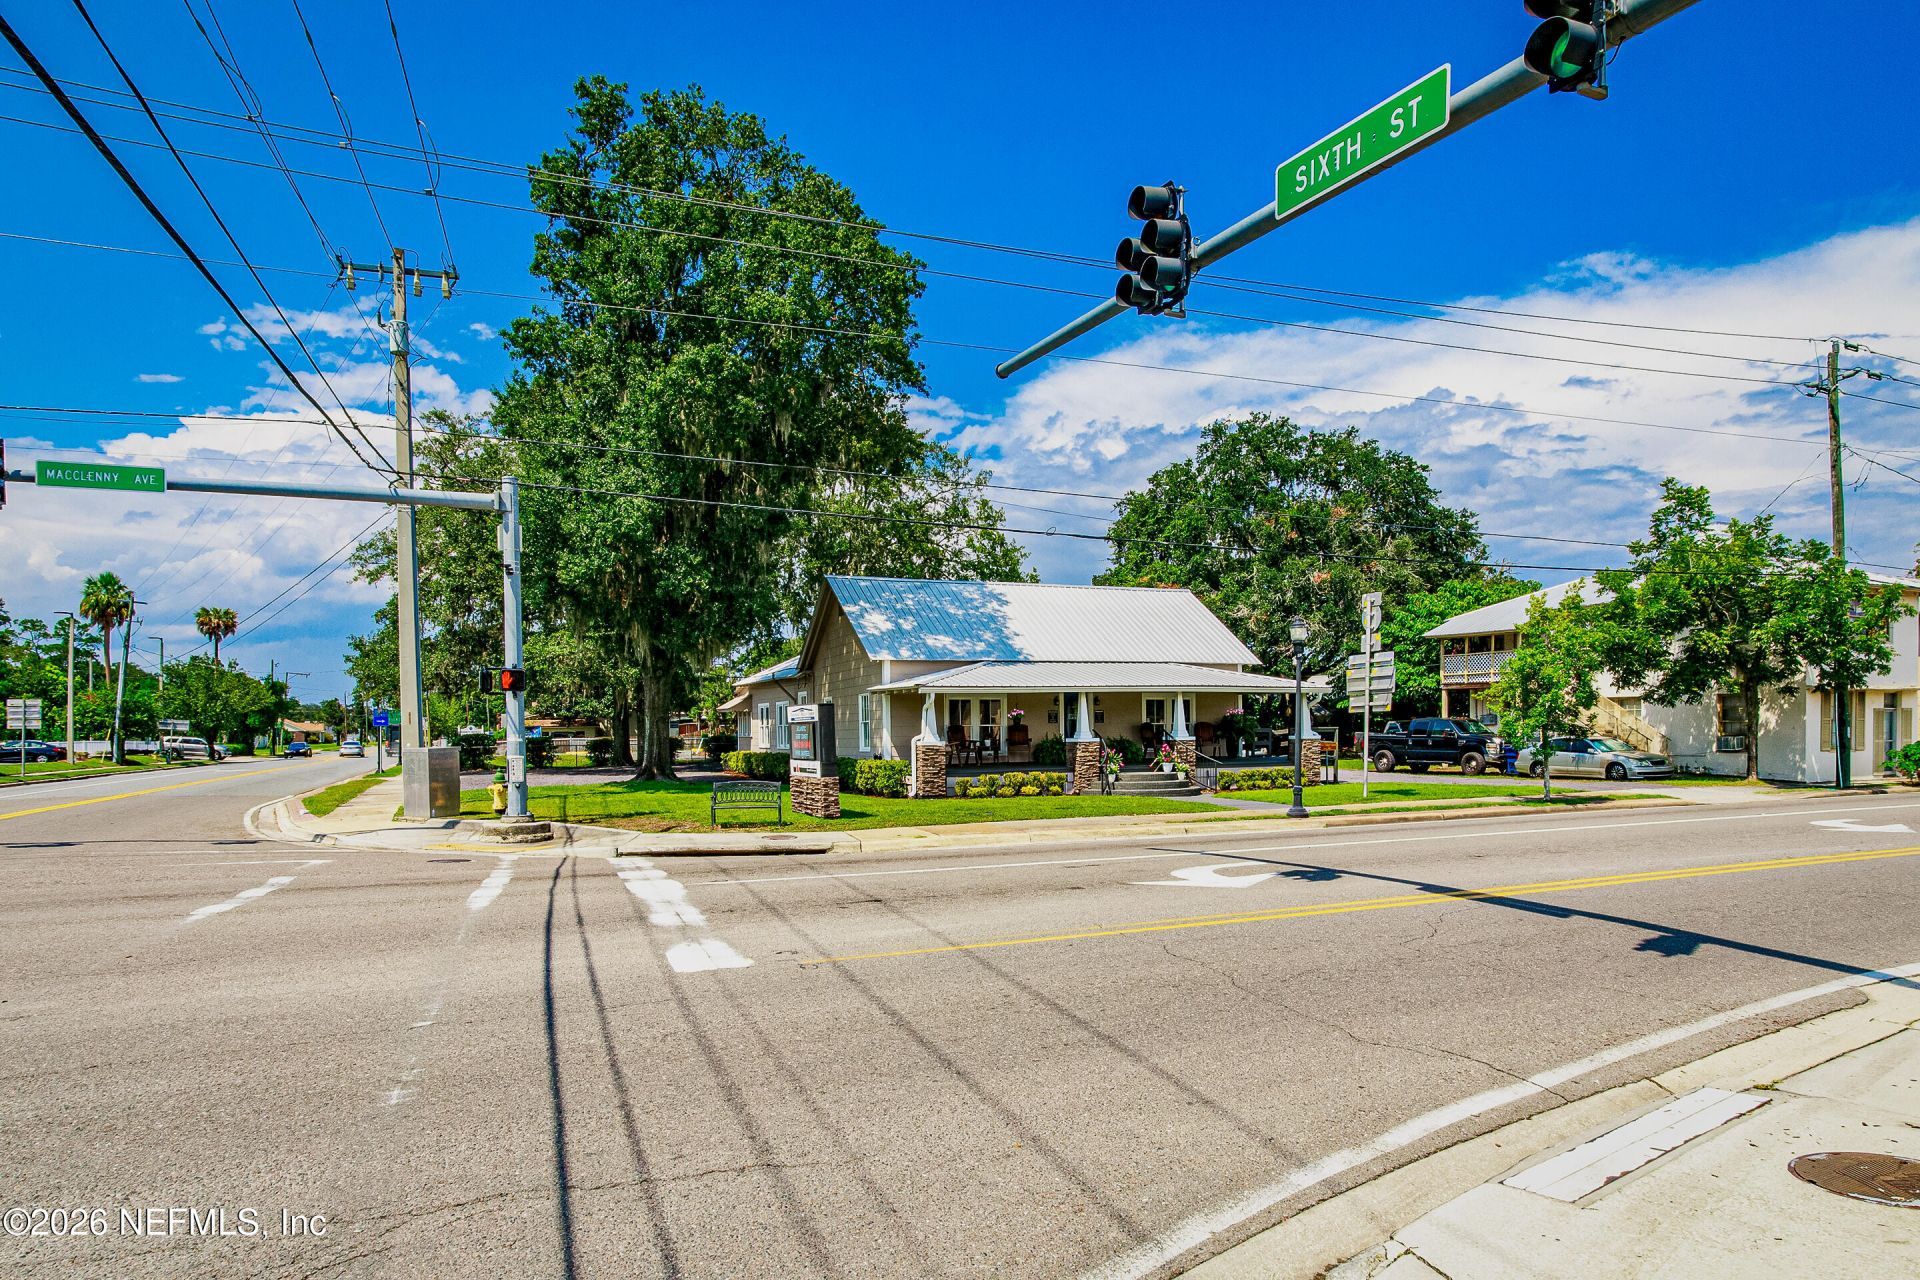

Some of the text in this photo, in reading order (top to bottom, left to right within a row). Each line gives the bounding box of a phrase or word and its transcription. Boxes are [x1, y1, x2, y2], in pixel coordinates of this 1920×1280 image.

[1295, 95, 1422, 192] SIXTH ST
[46, 469, 119, 482] MACCLENNY
